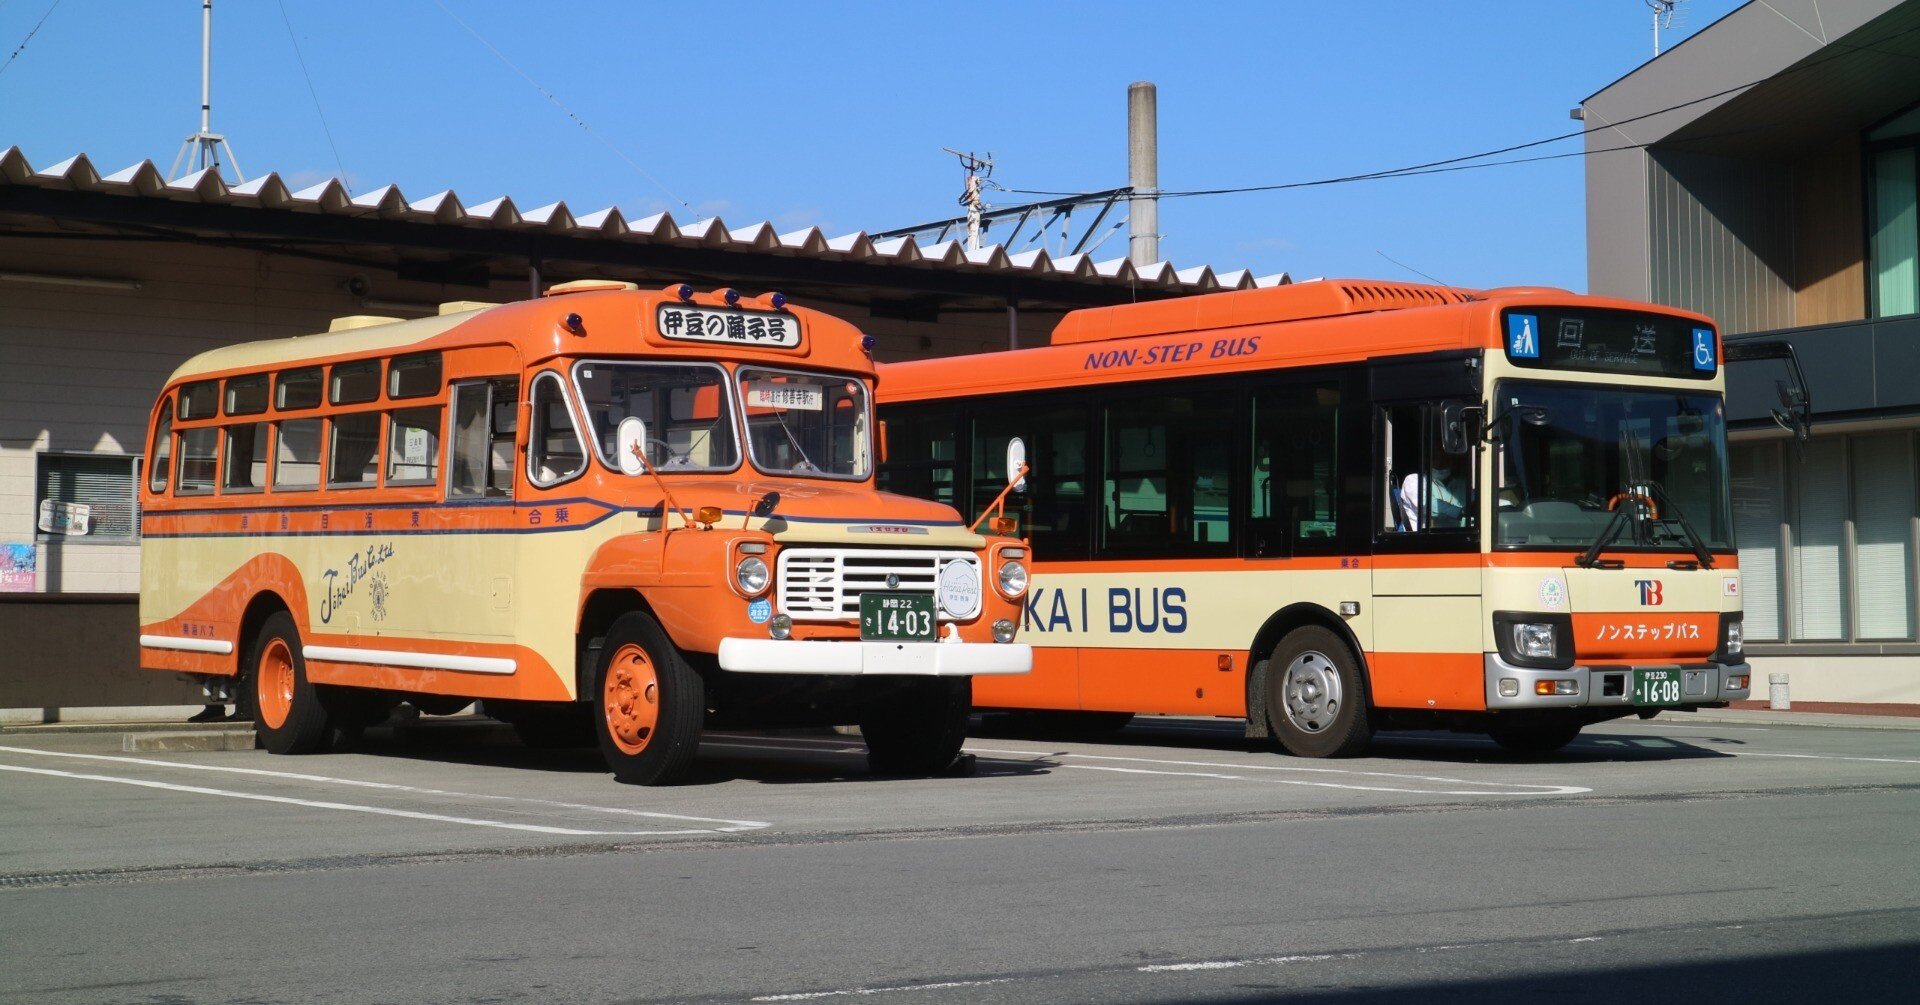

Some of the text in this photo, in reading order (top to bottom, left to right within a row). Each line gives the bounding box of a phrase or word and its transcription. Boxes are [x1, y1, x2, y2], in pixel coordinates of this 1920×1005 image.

[664, 310, 786, 342] 伊豆の踊子号
[1084, 336, 1262, 370] NON-STEP BUS
[1634, 579, 1664, 606] TB
[877, 609, 931, 636] 14-03
[1108, 587, 1188, 634] BUS
[1596, 622, 1700, 641] ノンステップバス
[1643, 680, 1680, 703] 16-08
